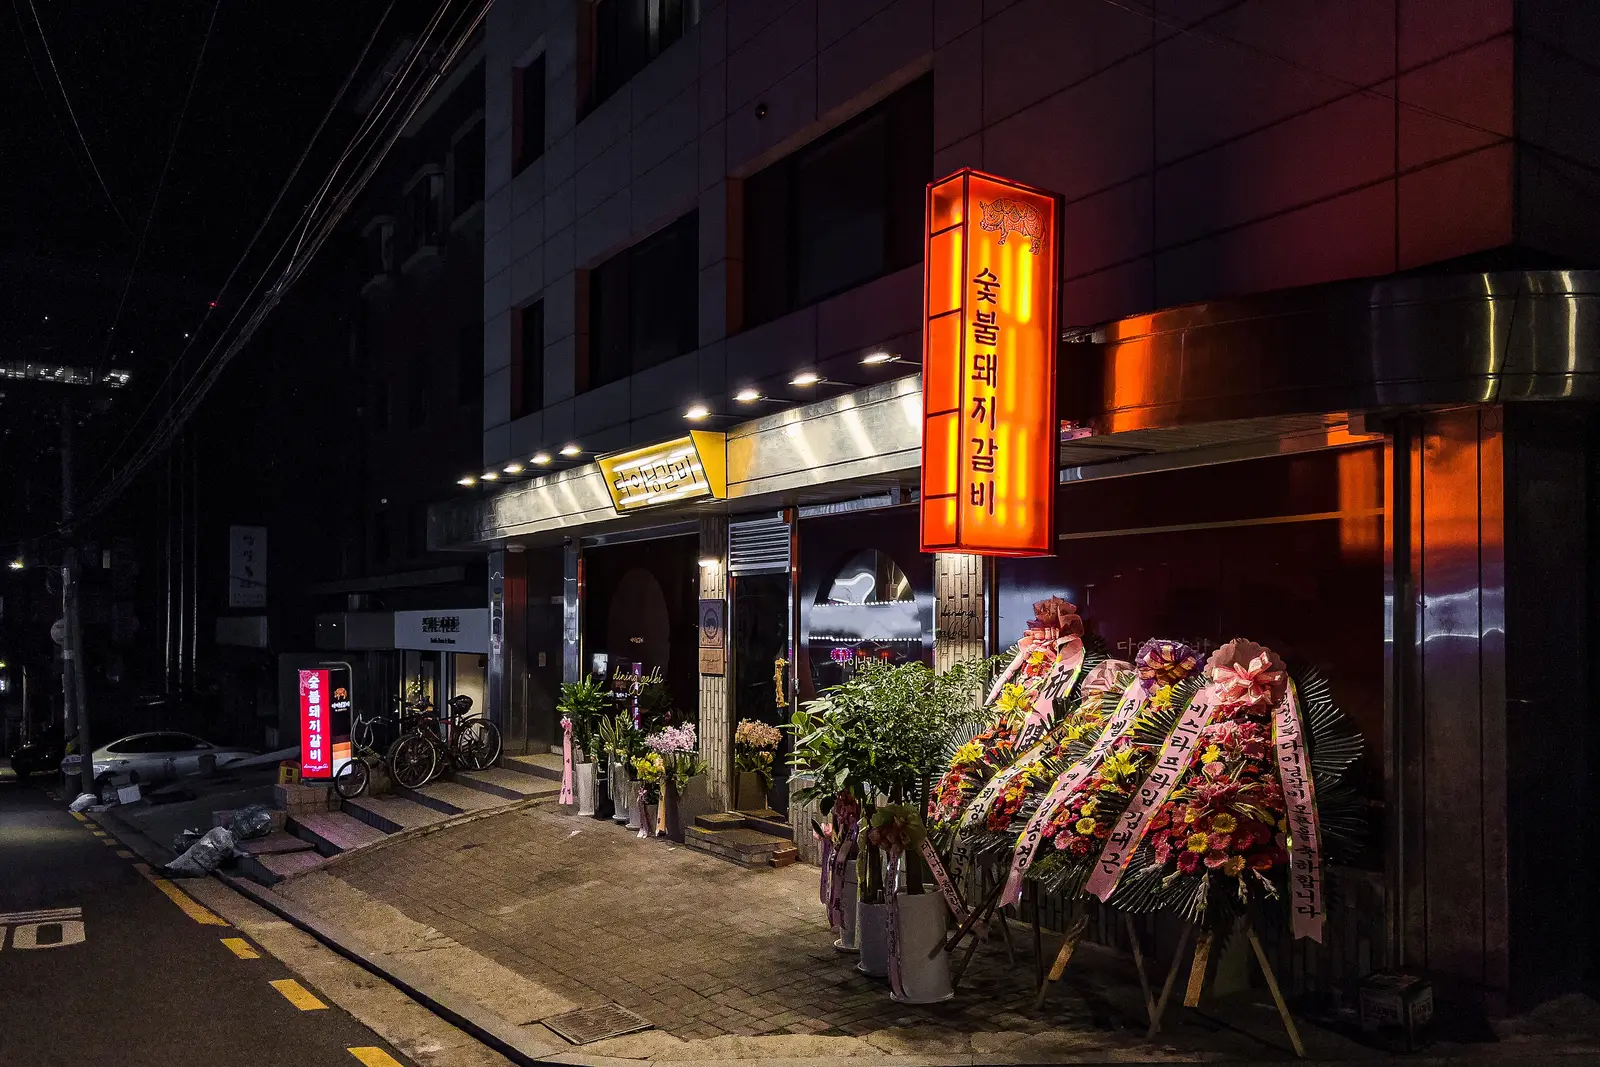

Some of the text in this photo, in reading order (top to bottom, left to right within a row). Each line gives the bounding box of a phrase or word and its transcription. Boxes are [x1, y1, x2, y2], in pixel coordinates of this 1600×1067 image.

[970, 267, 1001, 516] 숯불돼지갈비
[613, 454, 698, 497] 다이닝갈비
[307, 675, 321, 763] 숯불돼지갈비
